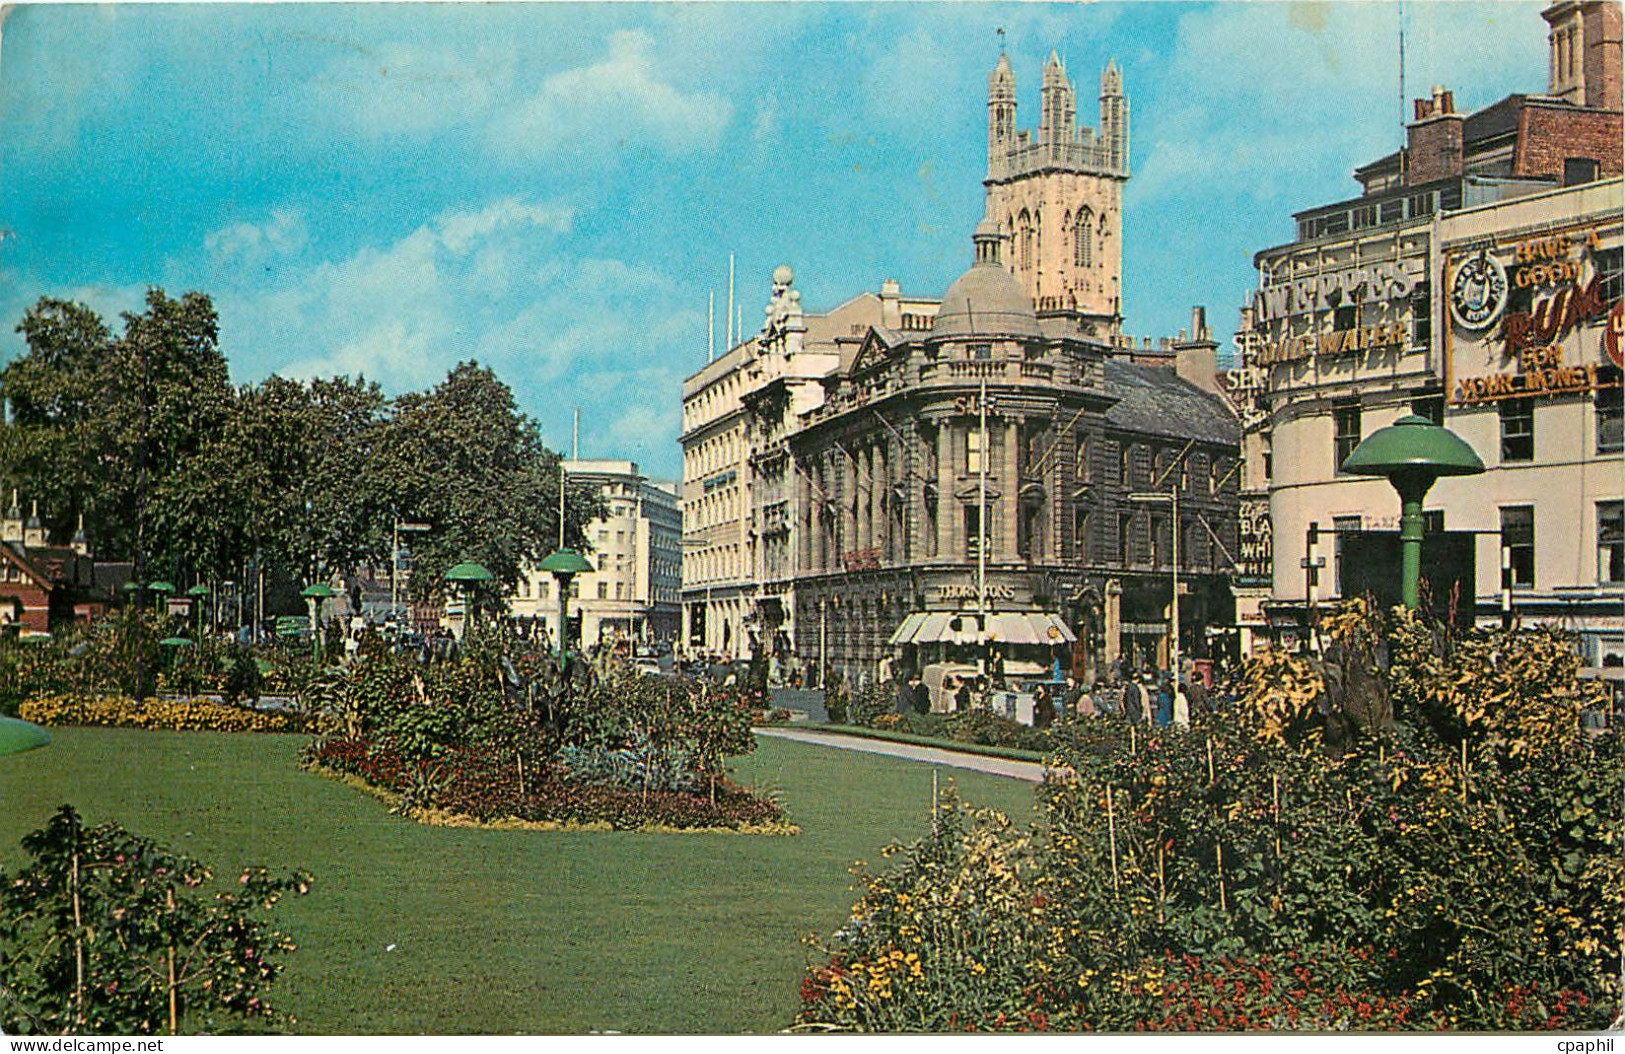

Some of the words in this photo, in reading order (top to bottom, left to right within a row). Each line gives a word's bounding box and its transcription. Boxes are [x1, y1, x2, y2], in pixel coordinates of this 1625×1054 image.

[1516, 261, 1582, 288] GOOD
[1319, 322, 1405, 355] WATER
[1522, 345, 1563, 370] FOR
[1459, 373, 1516, 399] YOUR
[1525, 364, 1597, 389] MONEY
